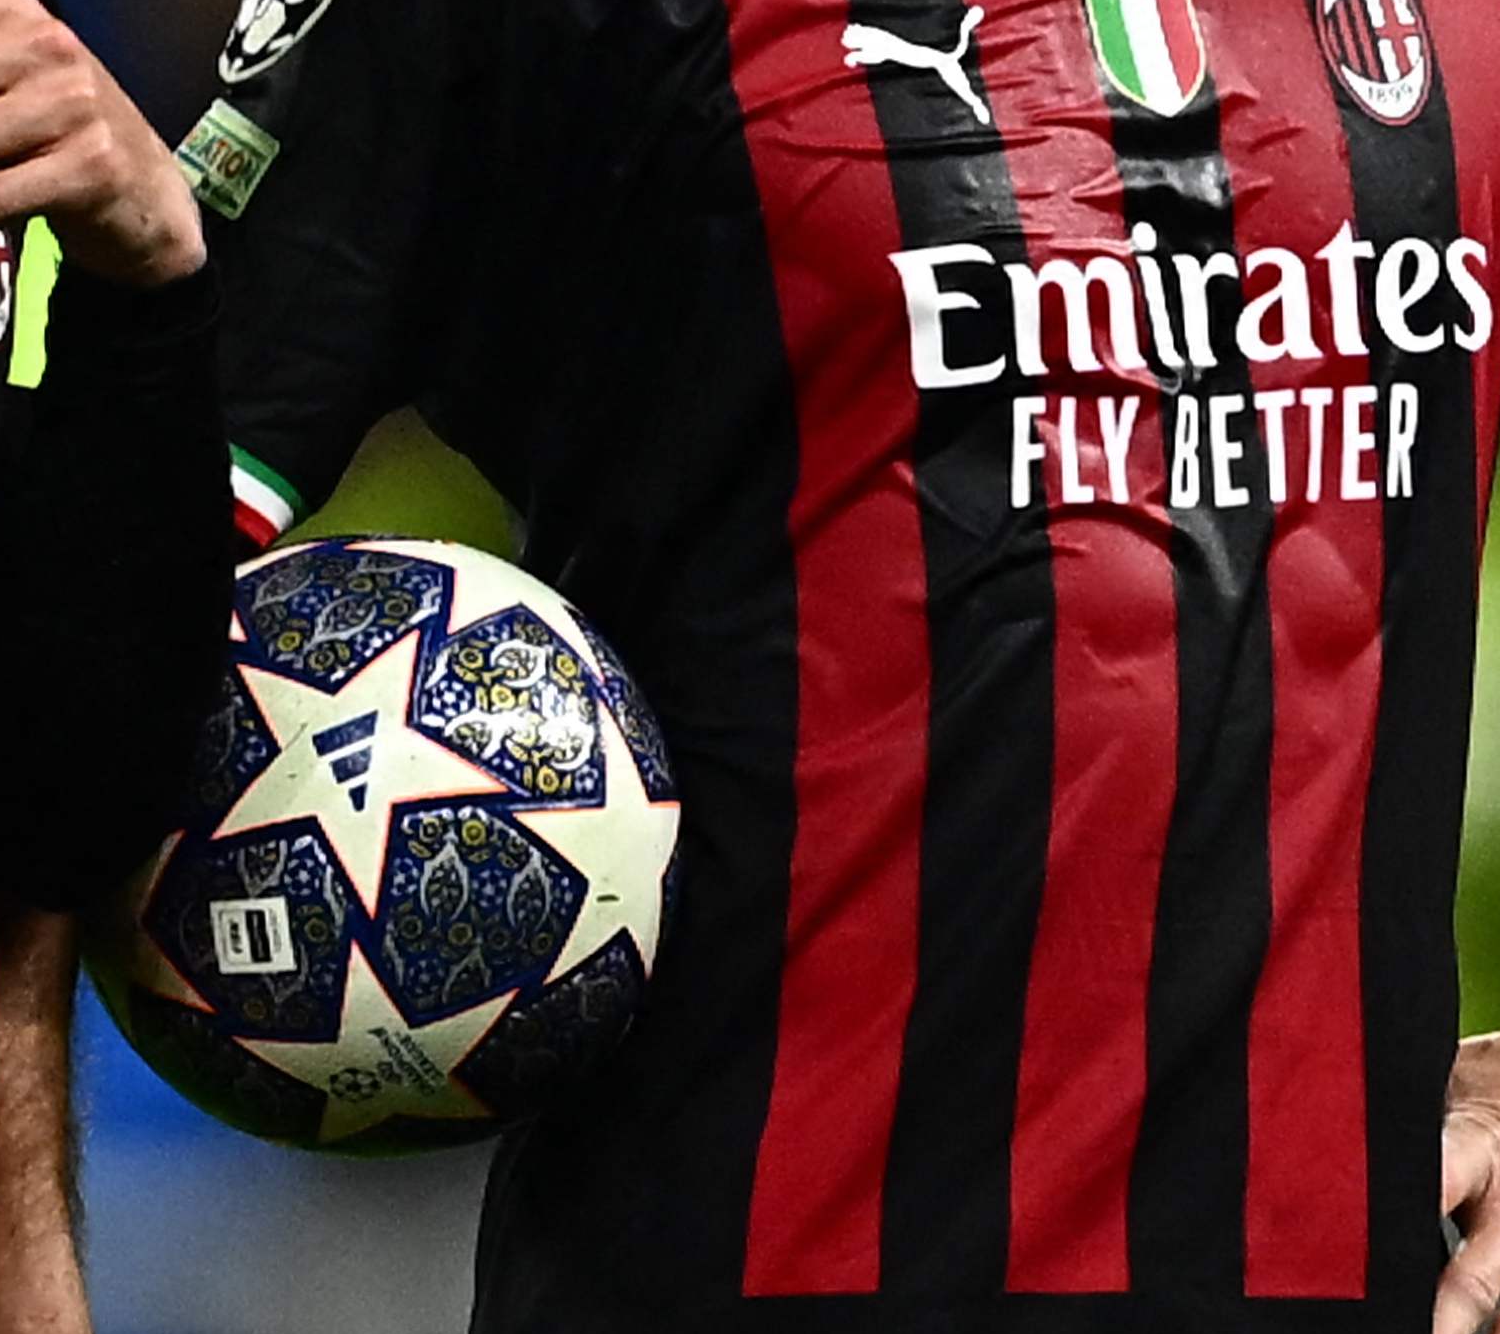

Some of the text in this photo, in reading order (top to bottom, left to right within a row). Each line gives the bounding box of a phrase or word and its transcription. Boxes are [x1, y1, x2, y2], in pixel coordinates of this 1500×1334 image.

[887, 219, 1494, 391] Emirates
[1009, 383, 1420, 510] FLY BETTER
